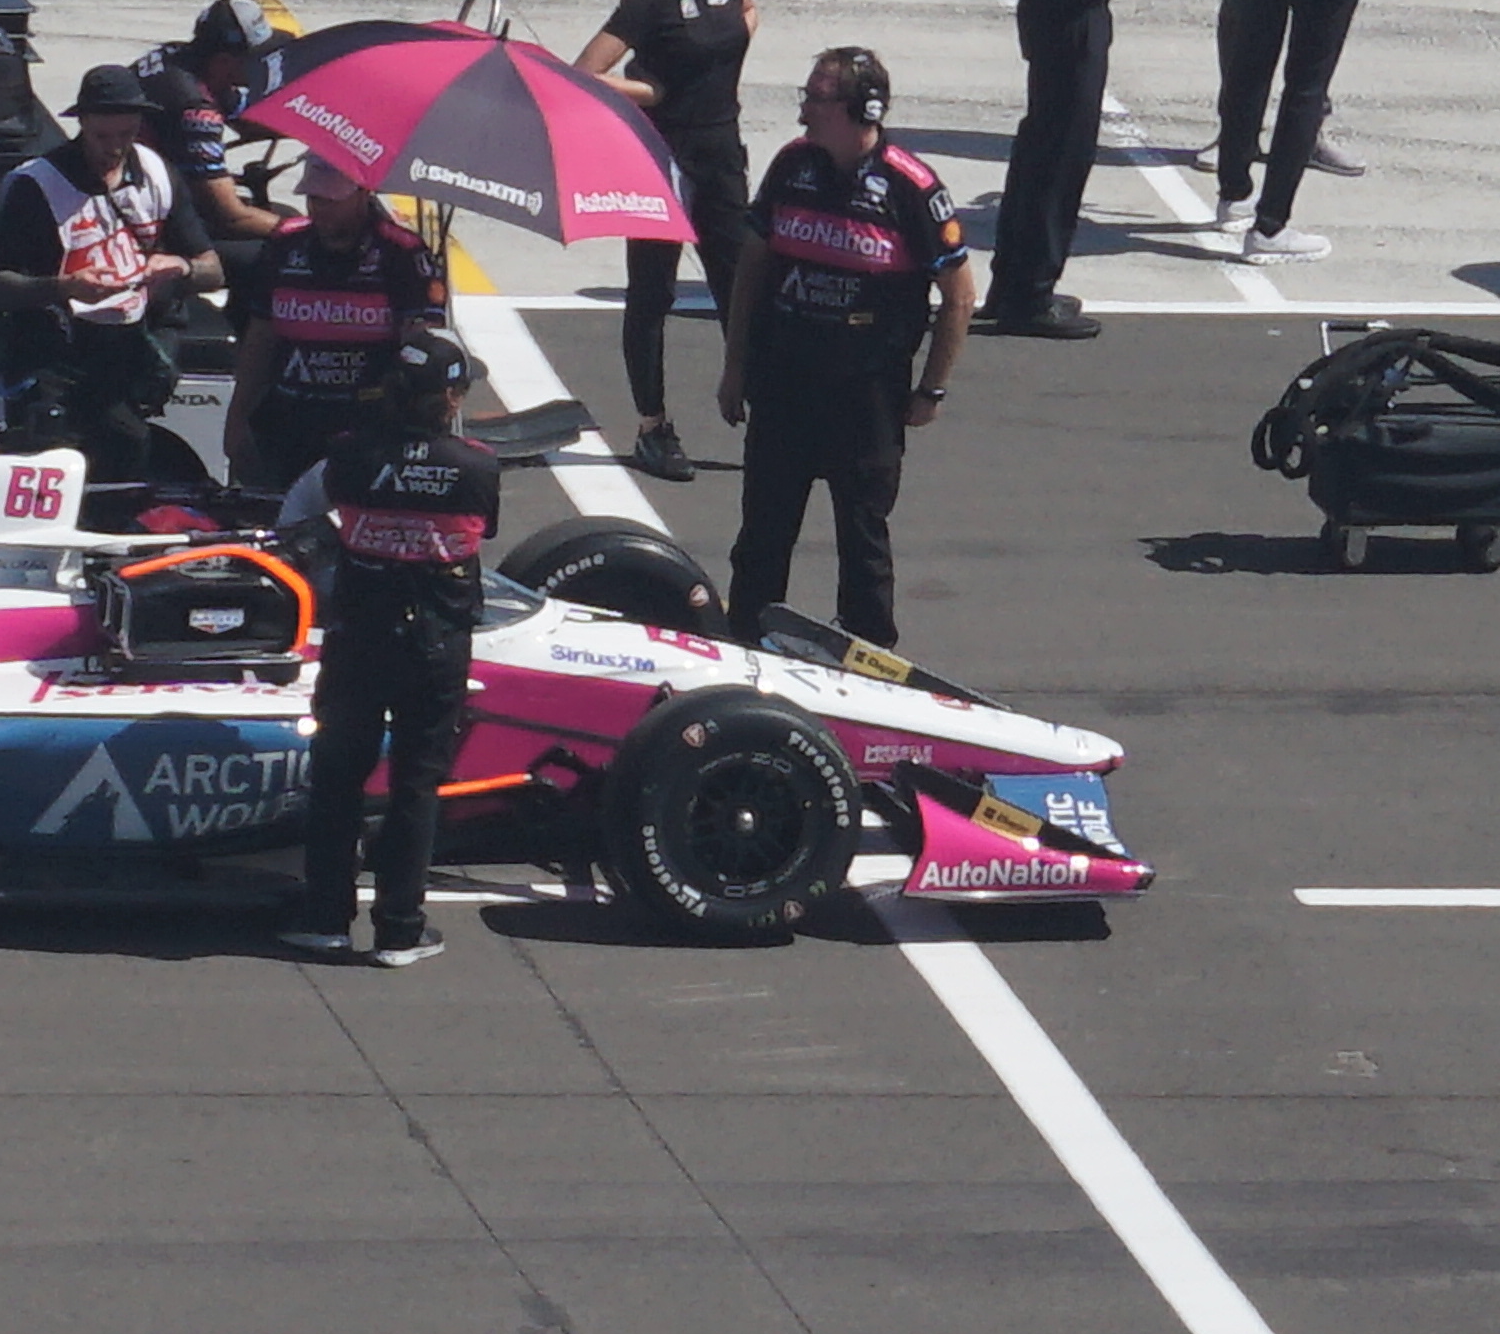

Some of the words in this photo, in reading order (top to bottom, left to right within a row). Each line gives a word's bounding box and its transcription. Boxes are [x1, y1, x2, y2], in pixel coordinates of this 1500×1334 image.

[3, 466, 65, 520] 66
[788, 729, 851, 830] Firestone
[644, 822, 707, 919] Firestone
[920, 858, 1091, 890] AutoNation
